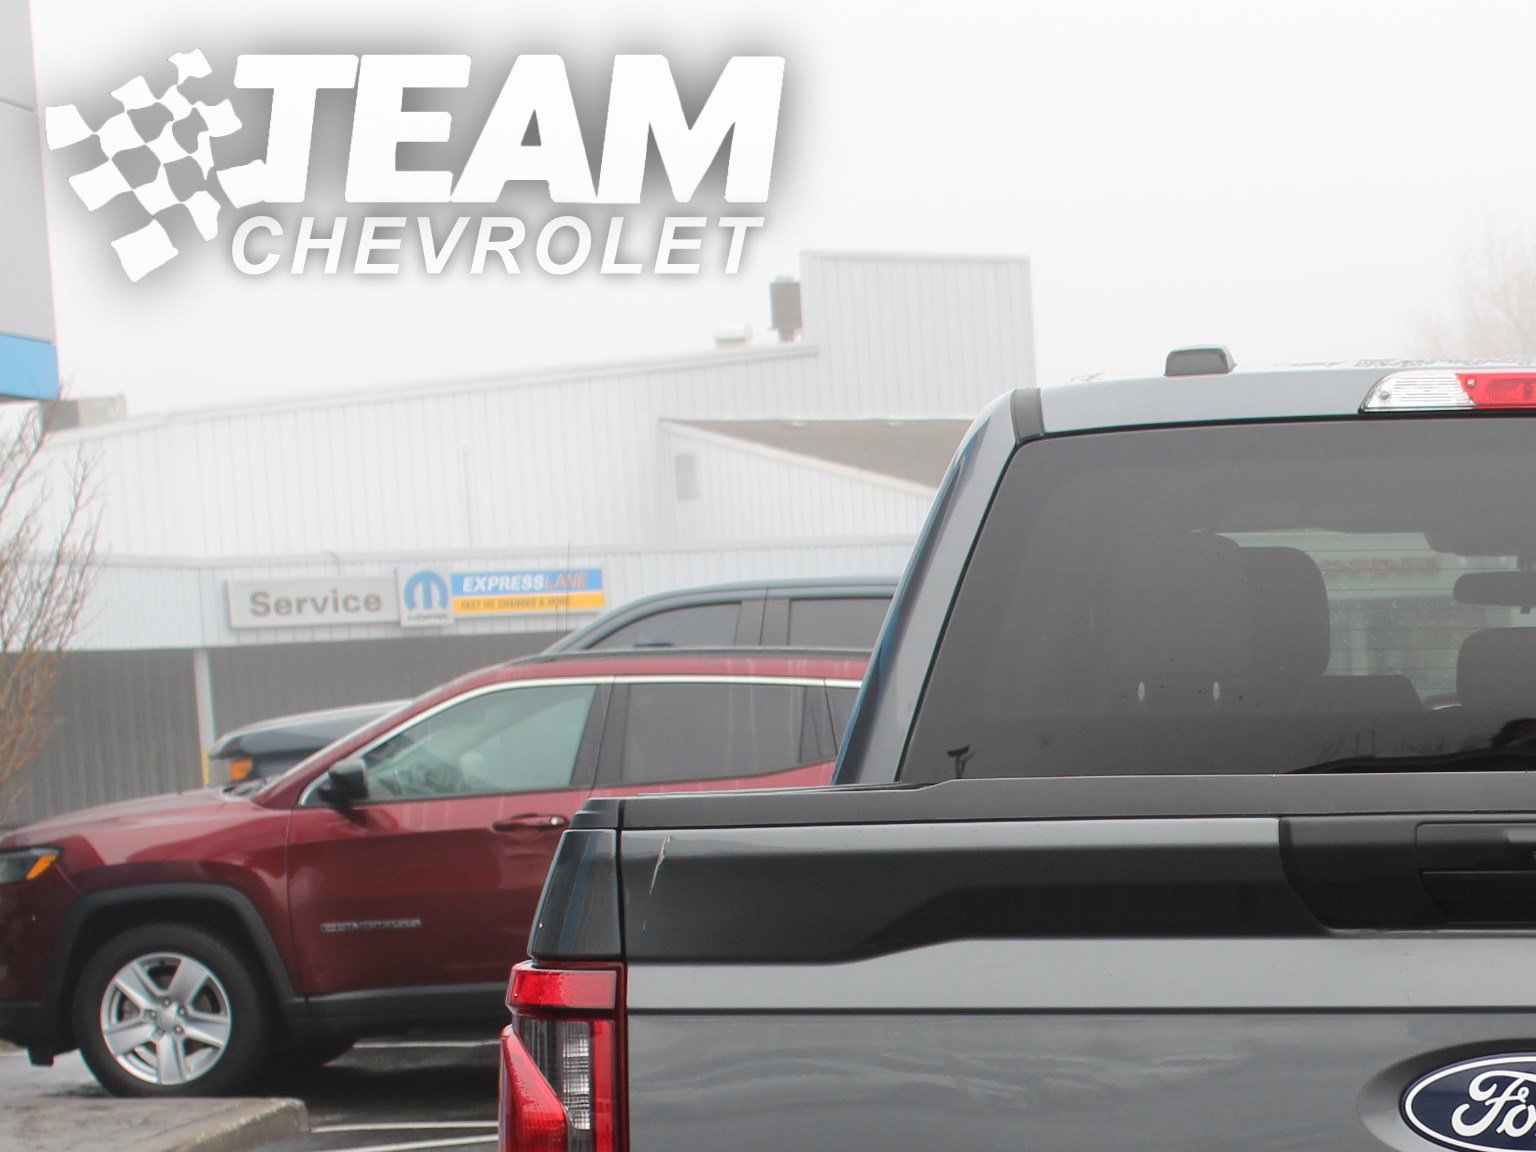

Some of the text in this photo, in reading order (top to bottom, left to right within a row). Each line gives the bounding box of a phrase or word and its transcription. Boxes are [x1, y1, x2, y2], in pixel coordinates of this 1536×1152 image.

[249, 588, 382, 617] Service
[461, 599, 480, 610] FAST
[483, 599, 495, 609] OIL
[498, 597, 537, 608] CHANGES
